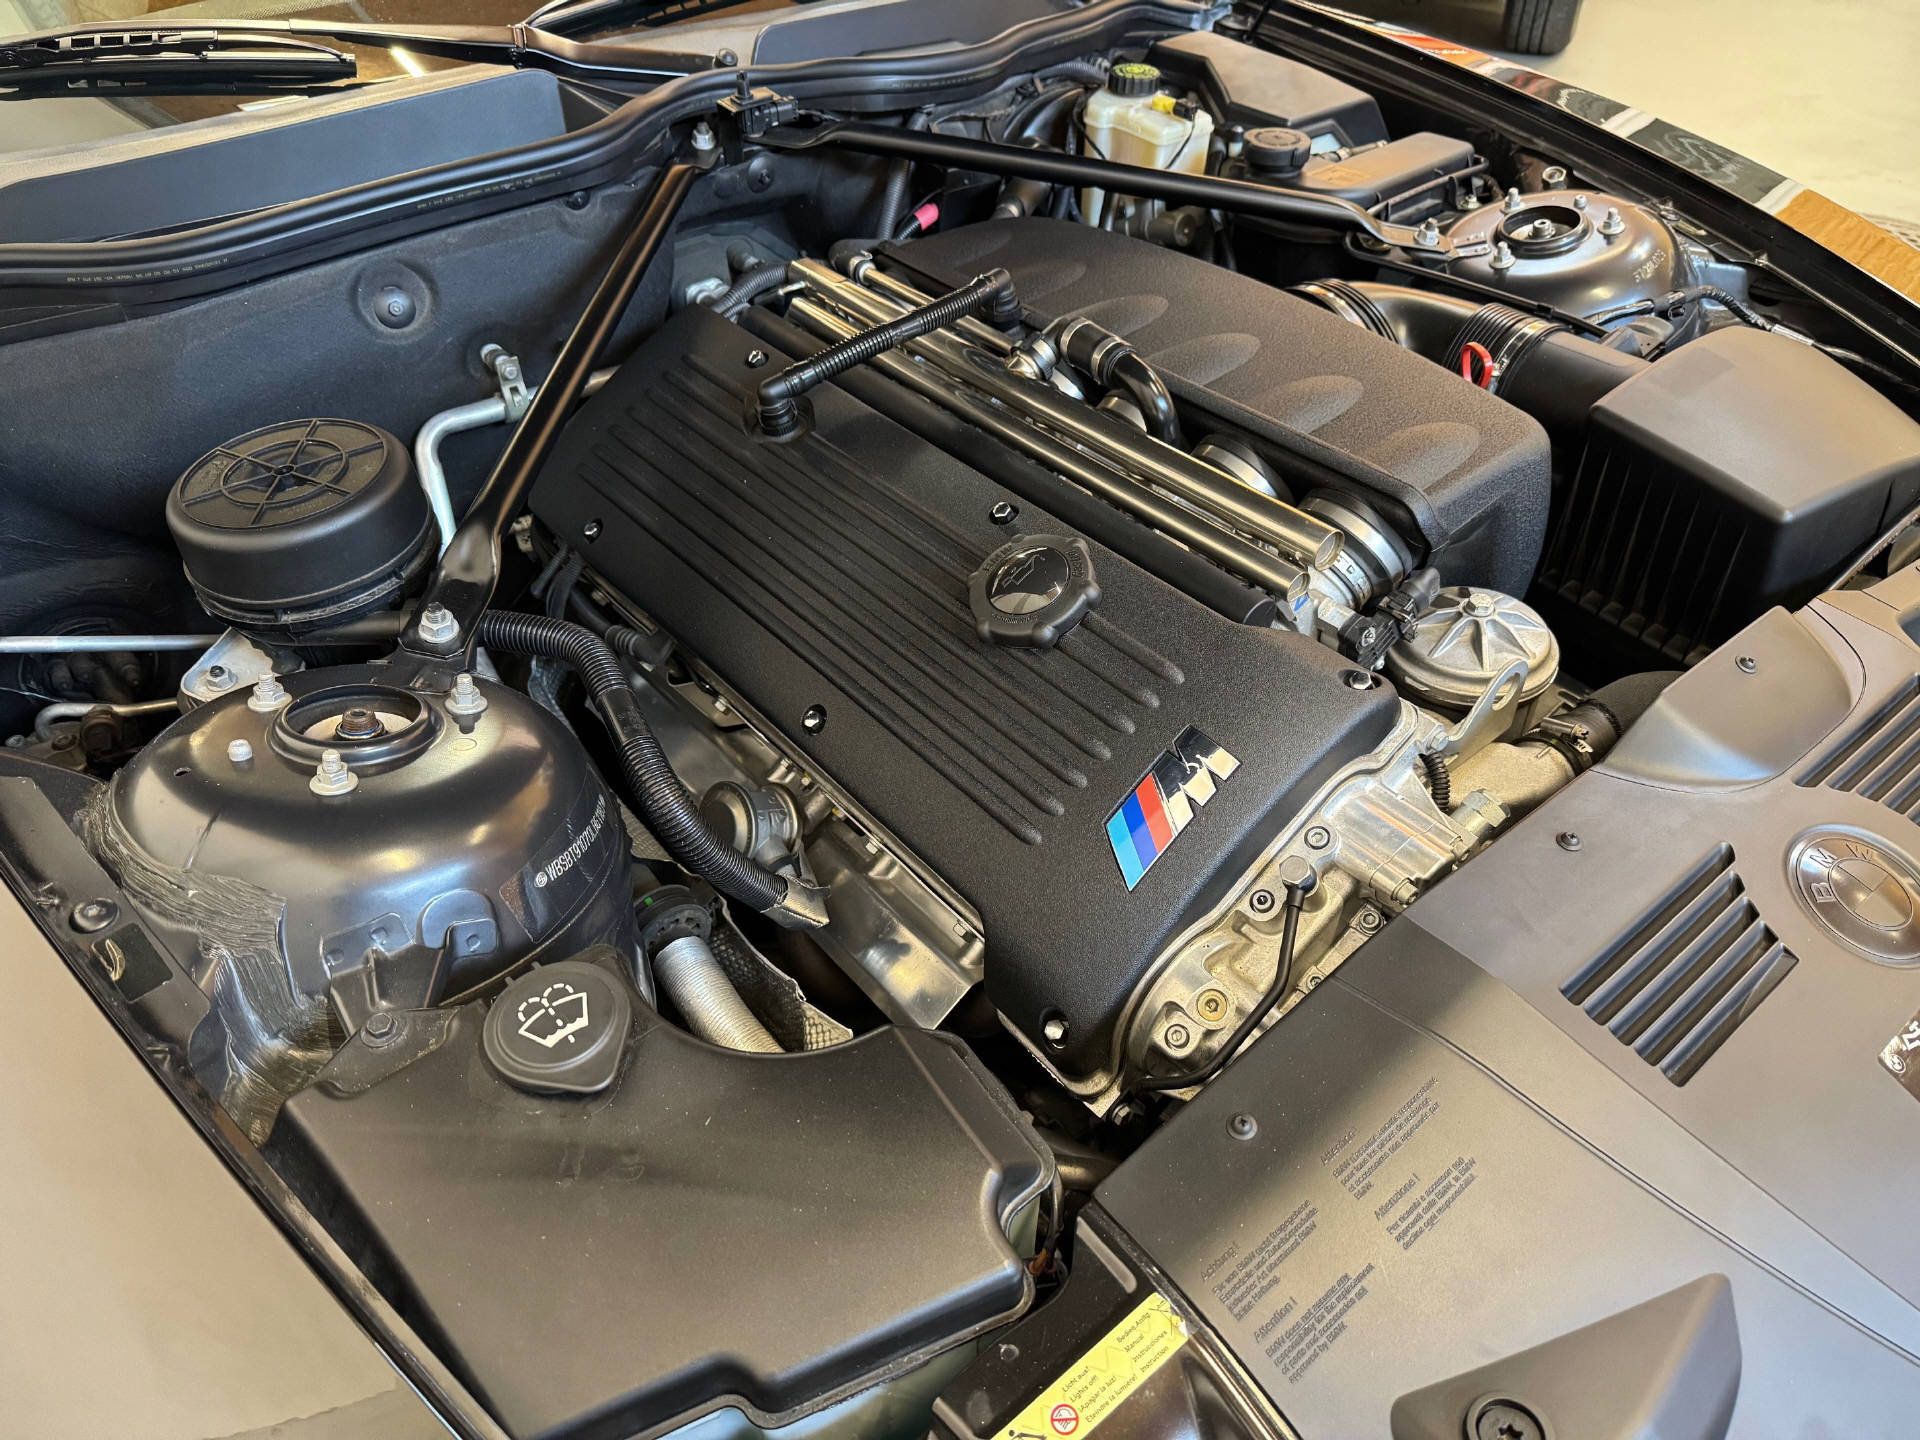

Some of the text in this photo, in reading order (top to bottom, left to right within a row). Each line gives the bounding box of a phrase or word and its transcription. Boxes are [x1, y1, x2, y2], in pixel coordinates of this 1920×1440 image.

[1809, 842, 1877, 903] BMW
[1332, 1159, 1351, 1177] BMW
[1458, 1157, 1476, 1175] BMW
[1372, 1176, 1415, 1220] Attenzione
[1297, 1221, 1316, 1240] BMW
[1385, 1219, 1400, 1234] Per
[1199, 1245, 1236, 1282] Achtung
[1235, 1251, 1256, 1271] BMW
[1312, 1310, 1327, 1324] for
[1322, 1299, 1337, 1314] the
[1333, 1263, 1375, 1302] replacement
[1251, 1301, 1293, 1343] Attention
[1265, 1272, 1350, 1356] BMW does not assume any
[1279, 1285, 1368, 1376] of parts and accessories not
[1140, 1346, 1169, 1371] Instruction
[1287, 1349, 1321, 1384] approved
[1315, 1339, 1330, 1353] by
[1061, 1377, 1077, 1392] Licht
[1069, 1384, 1089, 1402] Lights
